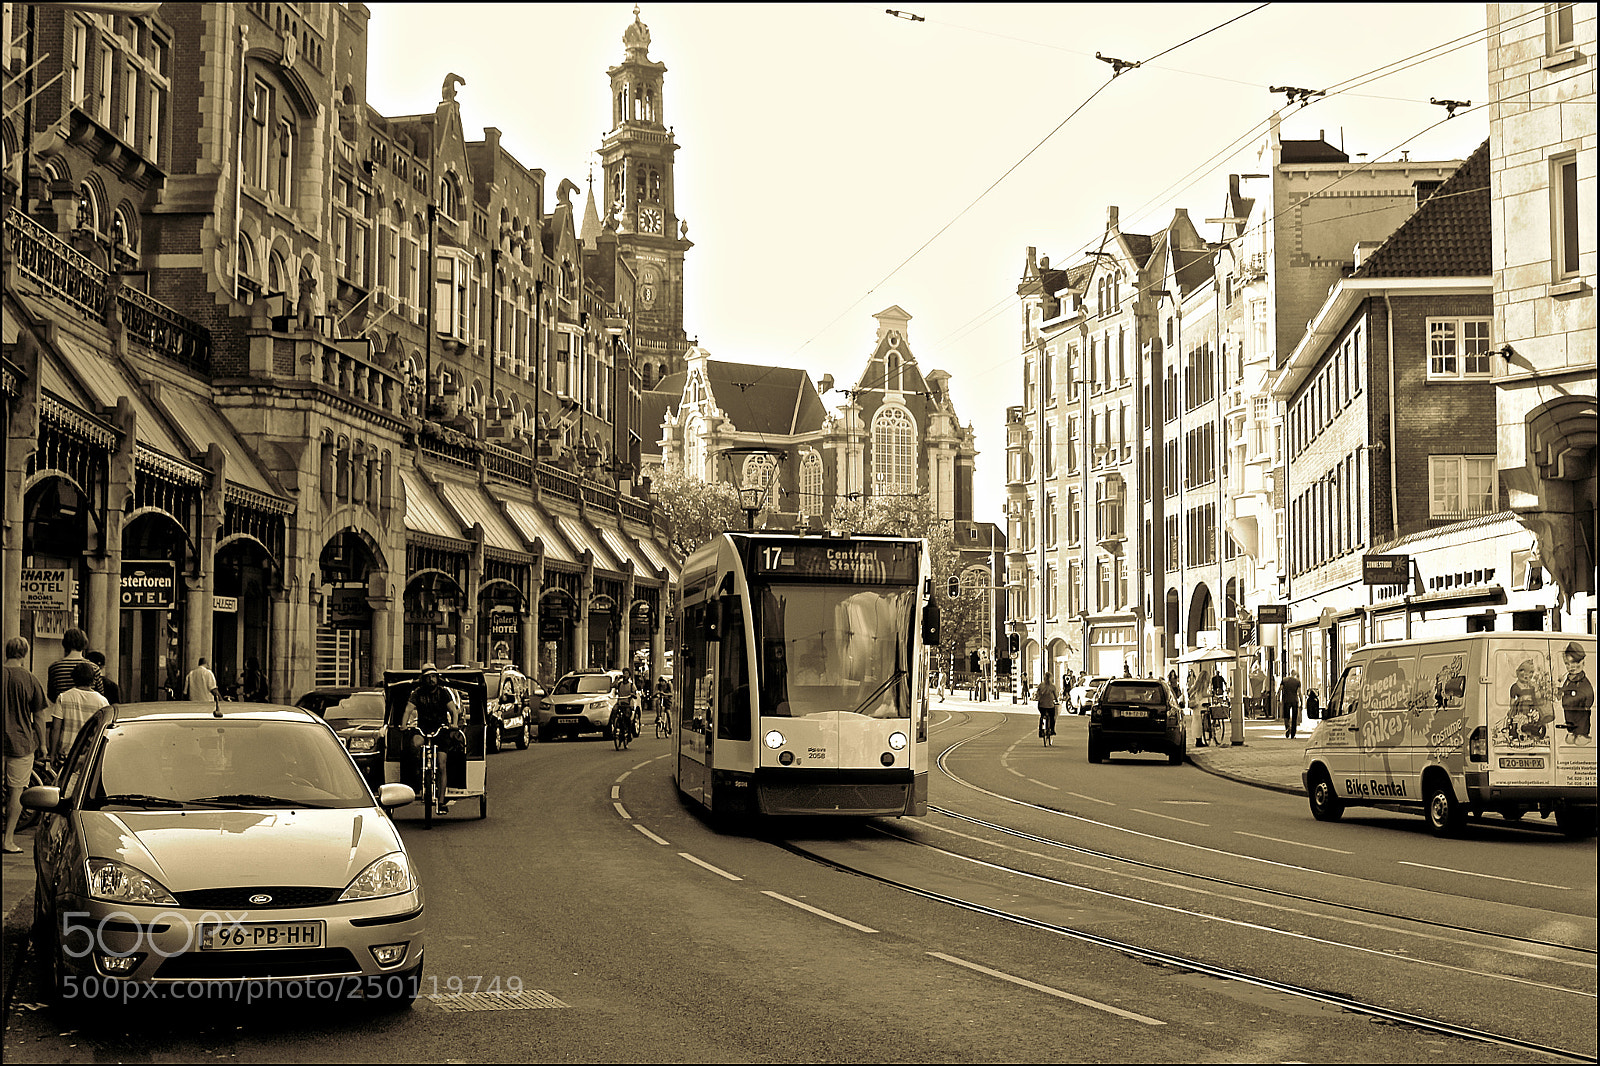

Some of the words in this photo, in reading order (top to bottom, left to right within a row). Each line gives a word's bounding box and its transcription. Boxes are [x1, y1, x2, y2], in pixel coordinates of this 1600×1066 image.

[763, 547, 781, 569] 17
[829, 560, 874, 571] Station
[21, 582, 63, 592] HOTEL
[122, 592, 168, 604] OTEL
[464, 624, 470, 634] P
[1242, 630, 1248, 639] P
[1362, 673, 1397, 709] Green
[1363, 714, 1402, 753] Bikes
[1345, 778, 1370, 797] Bike
[1370, 779, 1407, 797] Rental
[219, 925, 316, 946] 96-PB-HH
